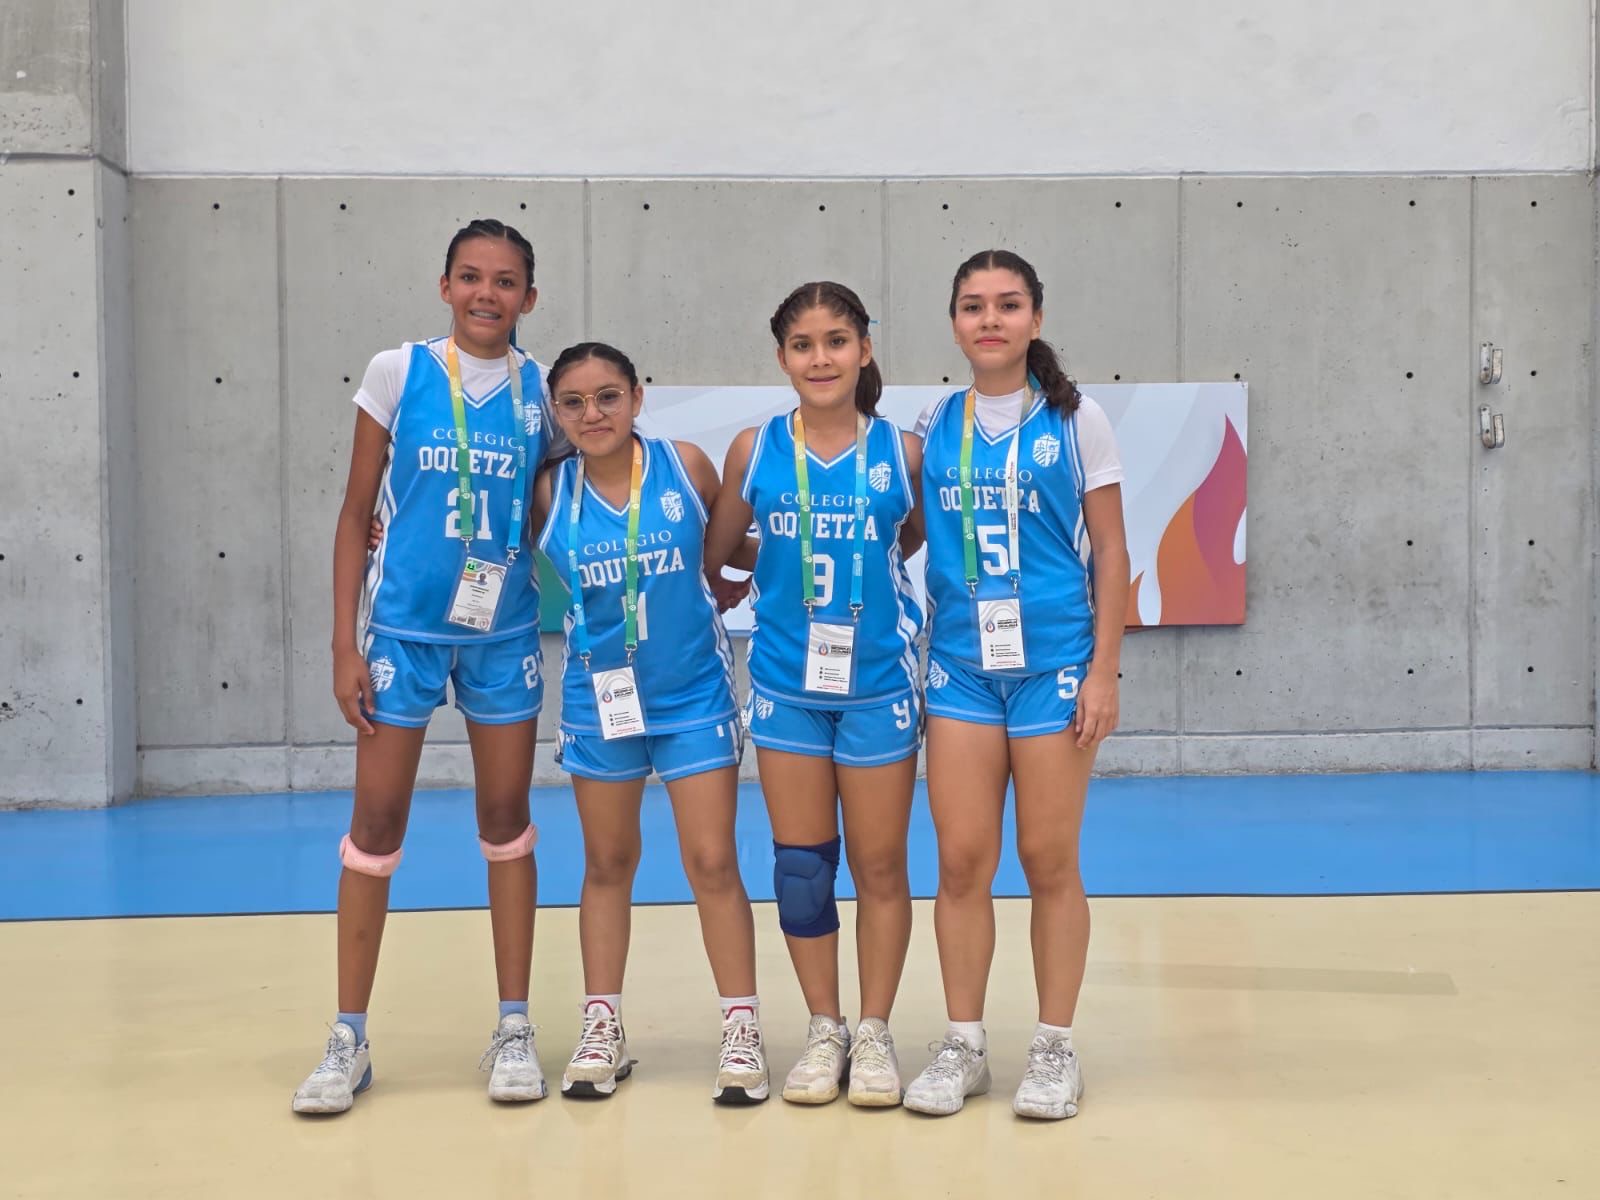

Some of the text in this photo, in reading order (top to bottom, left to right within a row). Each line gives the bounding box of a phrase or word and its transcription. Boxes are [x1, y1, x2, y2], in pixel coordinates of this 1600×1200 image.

[433, 427, 519, 449] COEGIO
[946, 466, 1033, 483] CLEGO
[445, 487, 493, 540] 21
[780, 492, 871, 507] CLEGI
[578, 546, 686, 588] OQUTZA
[977, 525, 1010, 576] 5
[1057, 665, 1079, 699] 5
